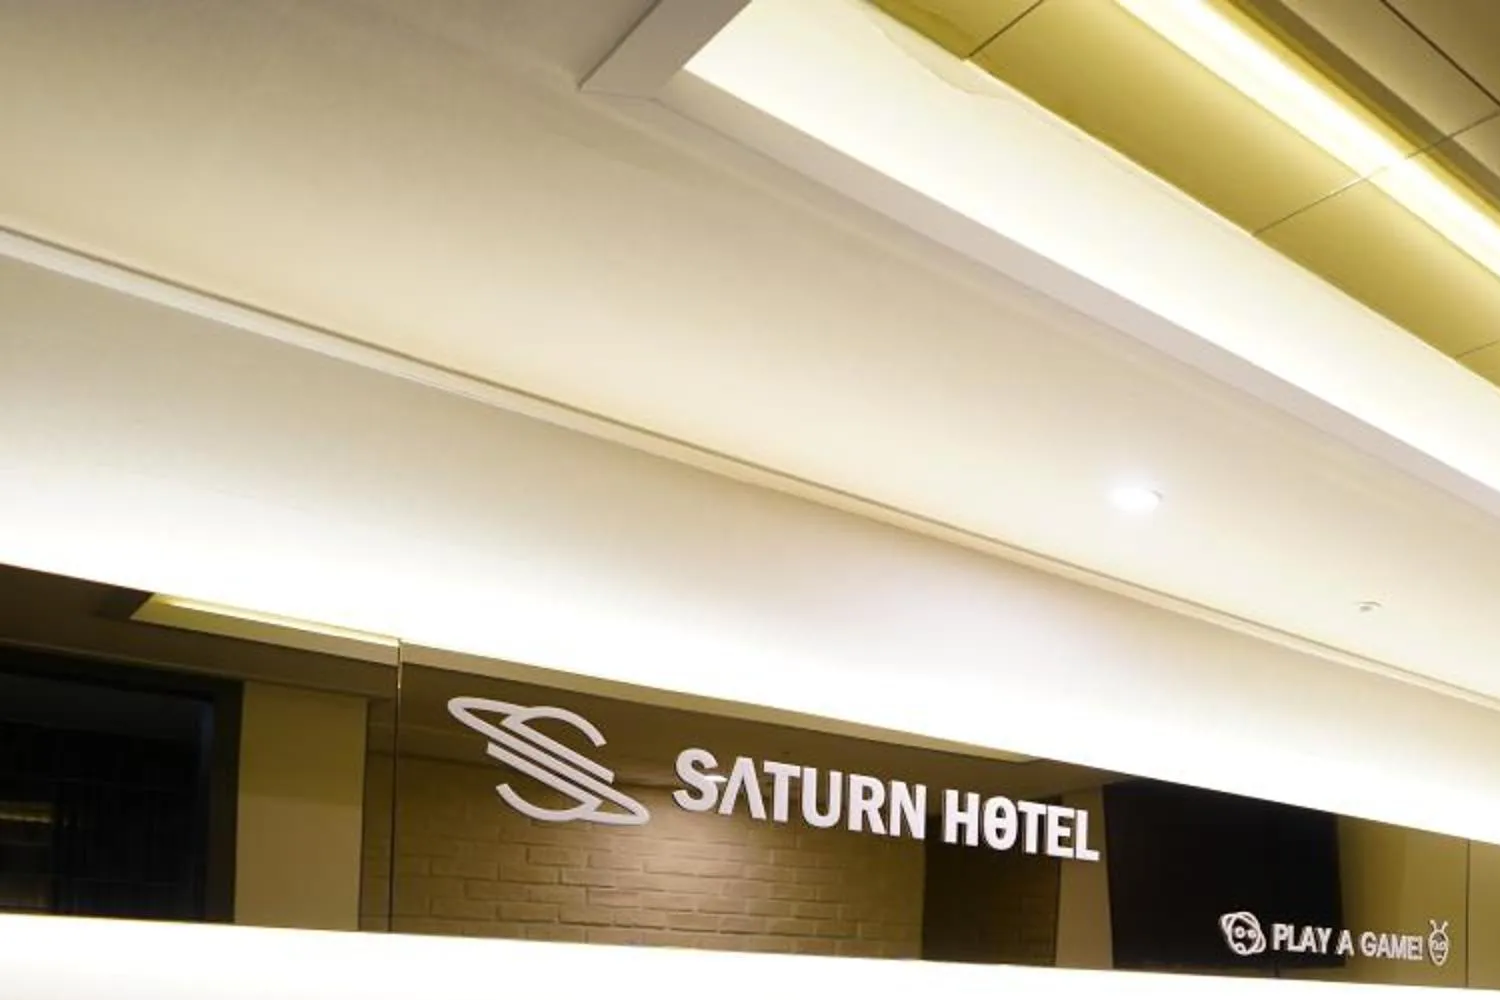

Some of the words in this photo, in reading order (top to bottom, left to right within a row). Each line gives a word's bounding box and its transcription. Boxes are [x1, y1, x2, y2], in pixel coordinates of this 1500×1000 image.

[672, 747, 927, 840] SATURN
[943, 789, 1100, 861] HOTEL
[1272, 923, 1332, 954] PLAY
[1336, 929, 1354, 956] A
[1360, 931, 1424, 961] GAME!
